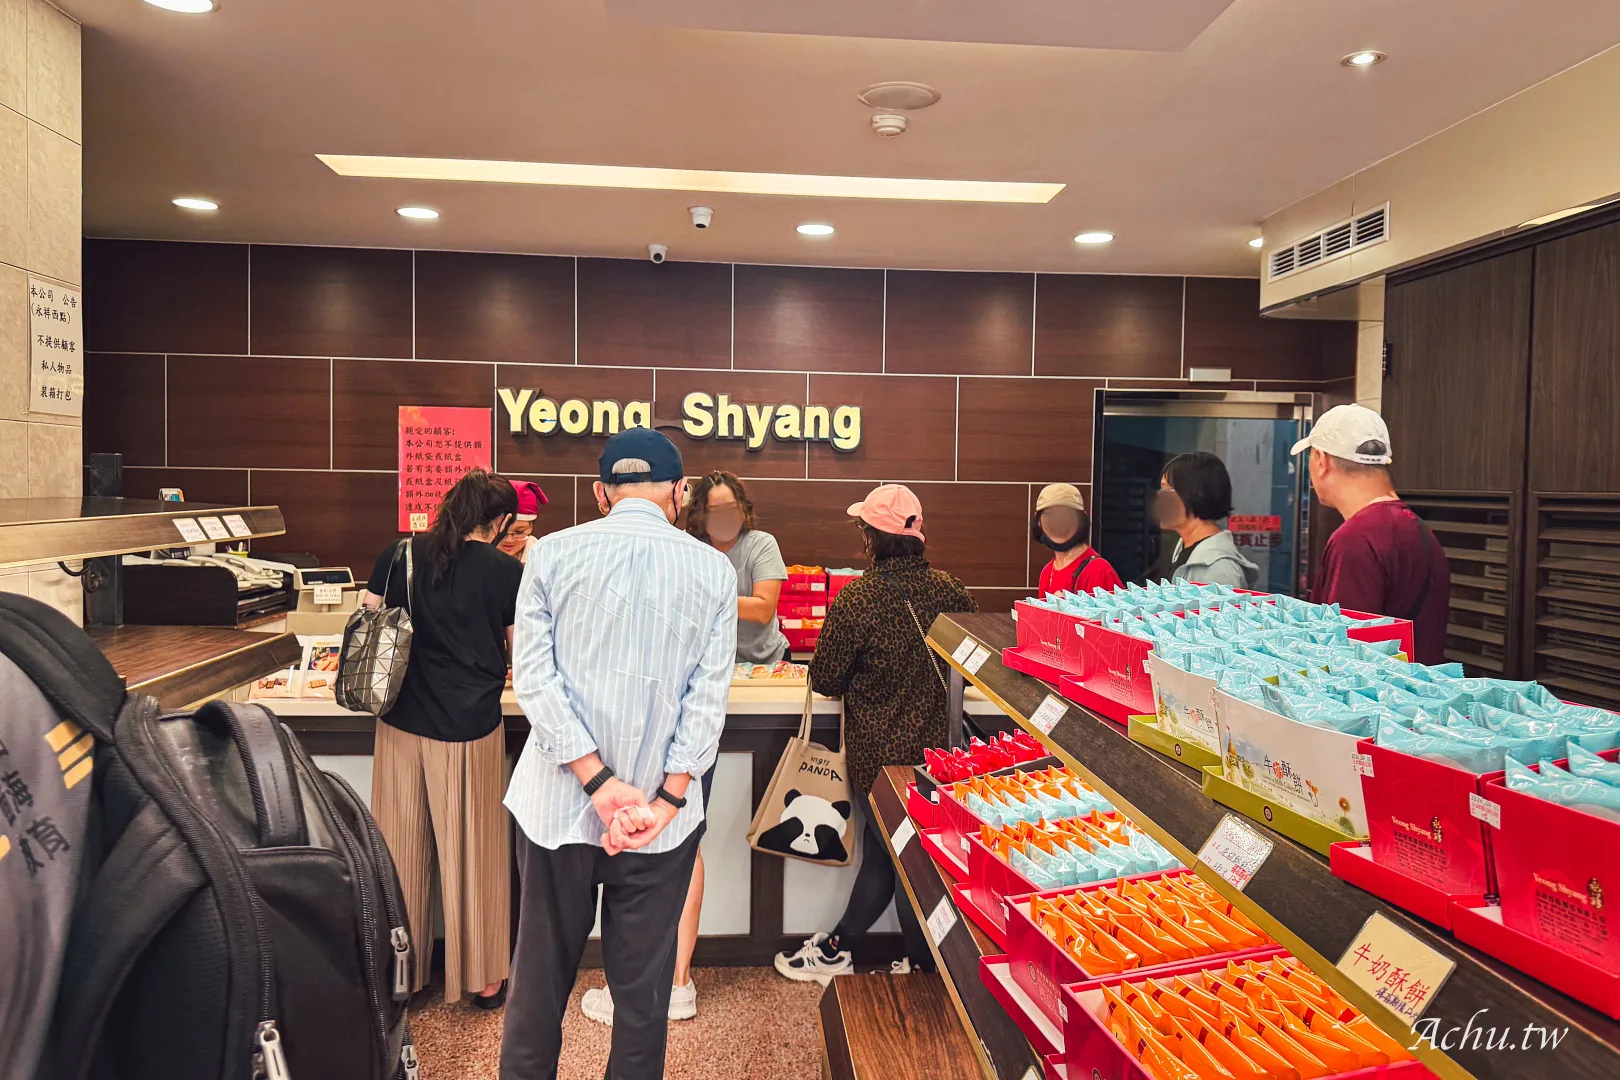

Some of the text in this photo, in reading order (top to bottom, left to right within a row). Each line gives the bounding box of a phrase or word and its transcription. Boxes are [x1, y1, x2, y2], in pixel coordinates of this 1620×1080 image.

[30, 285, 77, 308] 本公司 公告
[37, 334, 76, 352] 不提供顧客
[41, 360, 72, 374] 私人物品
[40, 385, 72, 401] 裝箱打包
[682, 391, 862, 451] Shyang
[1353, 942, 1431, 1008] 牛奶酥餅
